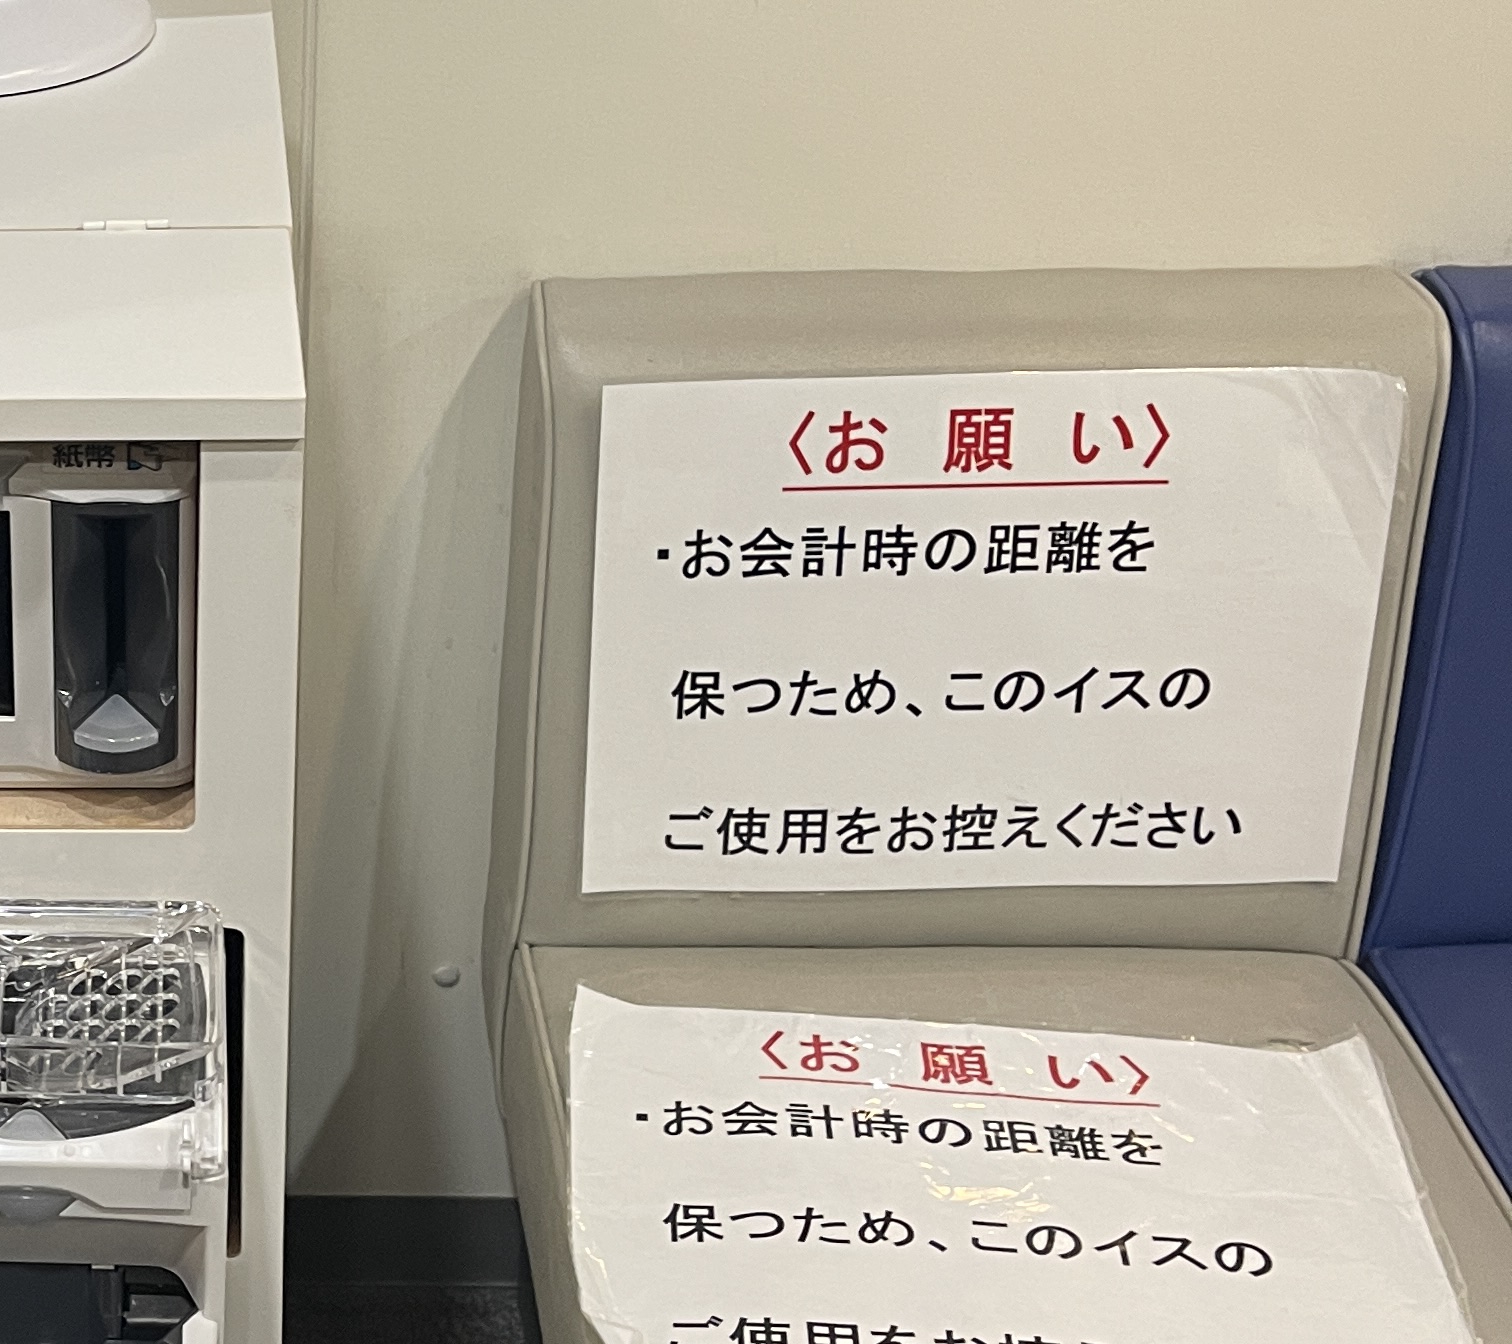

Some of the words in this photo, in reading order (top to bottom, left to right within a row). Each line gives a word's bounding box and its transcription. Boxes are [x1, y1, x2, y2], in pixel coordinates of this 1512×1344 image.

[52, 444, 115, 468] 紙幣
[671, 666, 1211, 720] 保つため、このイスの
[664, 801, 1243, 856] ご使用をお控えください
[662, 1203, 1274, 1278] 保つため、このイスの
